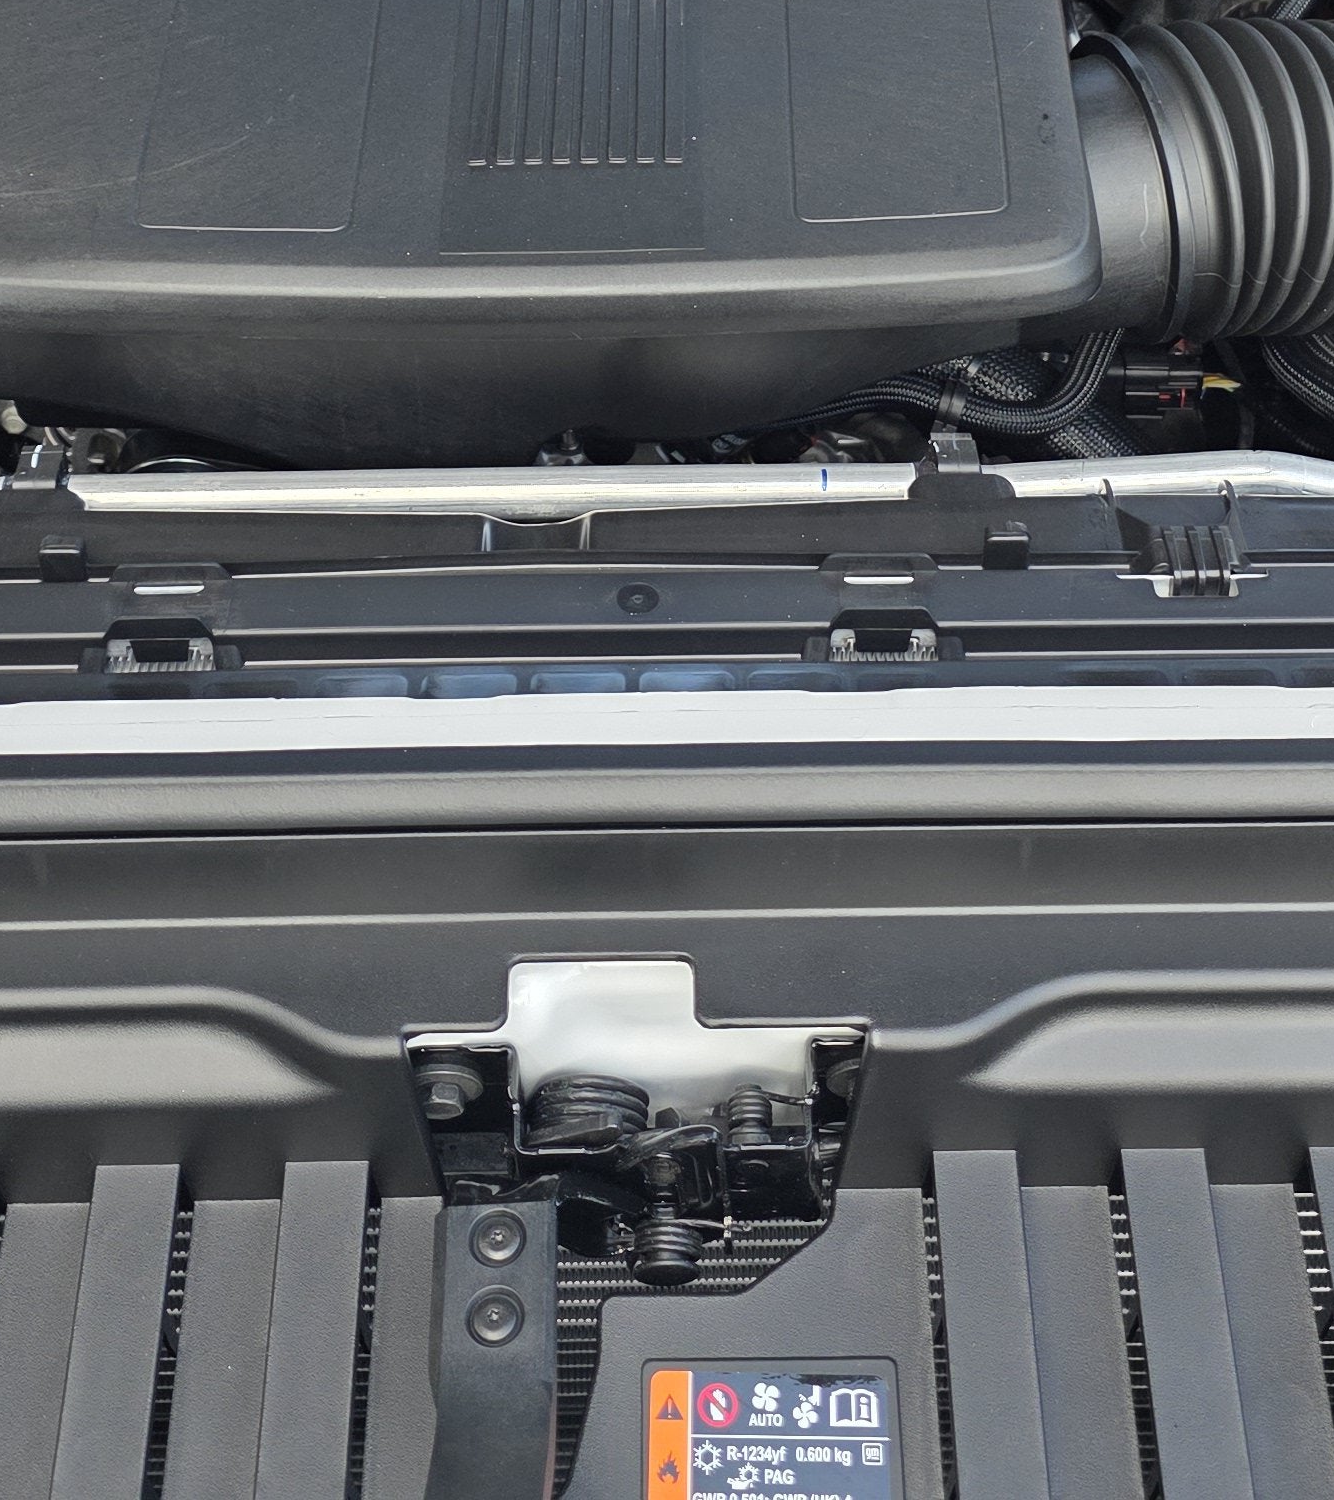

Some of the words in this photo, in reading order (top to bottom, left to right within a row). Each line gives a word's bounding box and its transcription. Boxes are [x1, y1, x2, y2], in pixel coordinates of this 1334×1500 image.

[749, 1413, 784, 1427] AUTO
[726, 1445, 788, 1465] R-1234yf
[795, 1446, 832, 1462] 0.600
[834, 1446, 852, 1466] kg
[764, 1468, 796, 1485] PAG
